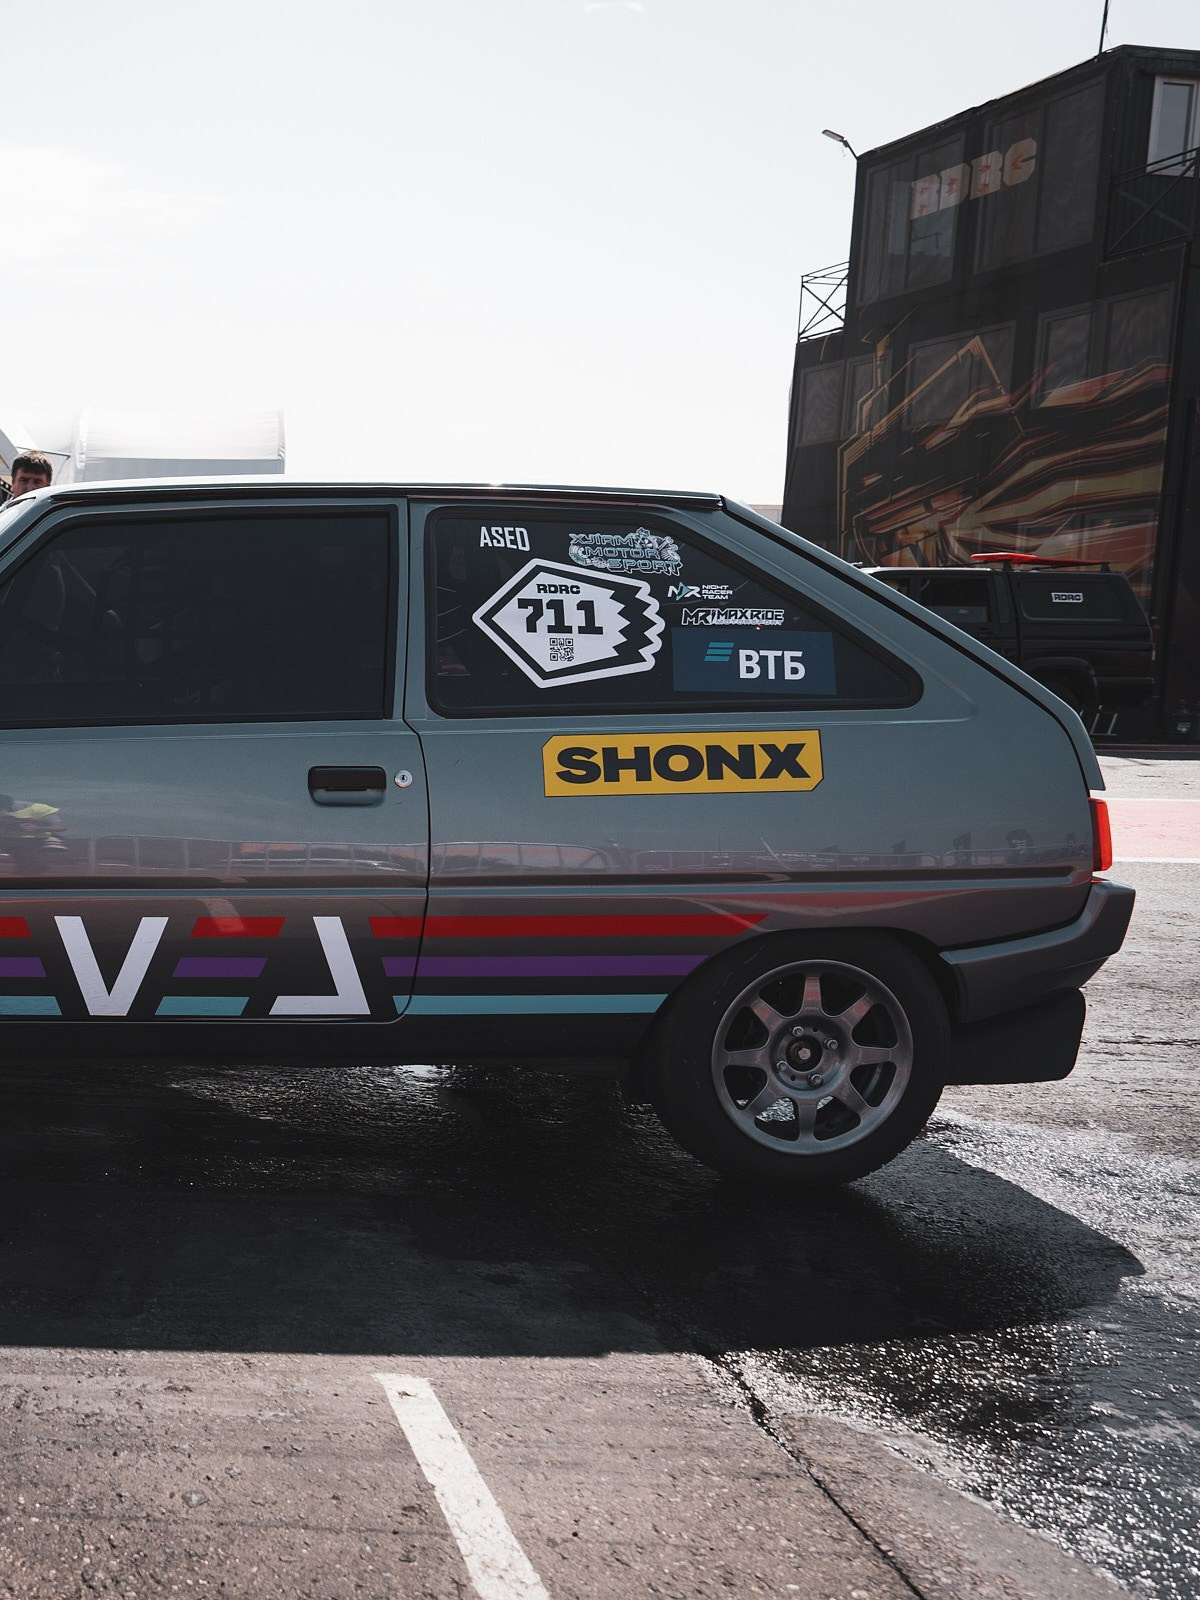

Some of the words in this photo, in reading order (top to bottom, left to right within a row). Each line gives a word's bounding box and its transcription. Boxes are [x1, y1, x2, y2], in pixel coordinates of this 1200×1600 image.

[909, 137, 1037, 220] RDRC
[480, 526, 530, 551] ASED
[585, 546, 660, 559] MOTOR
[607, 559, 680, 575] SPORT
[536, 583, 581, 595] RDRC
[1052, 593, 1083, 602] RDRC
[517, 598, 603, 635] 711
[739, 650, 806, 680] ВТБ
[555, 743, 811, 785] SHONX
